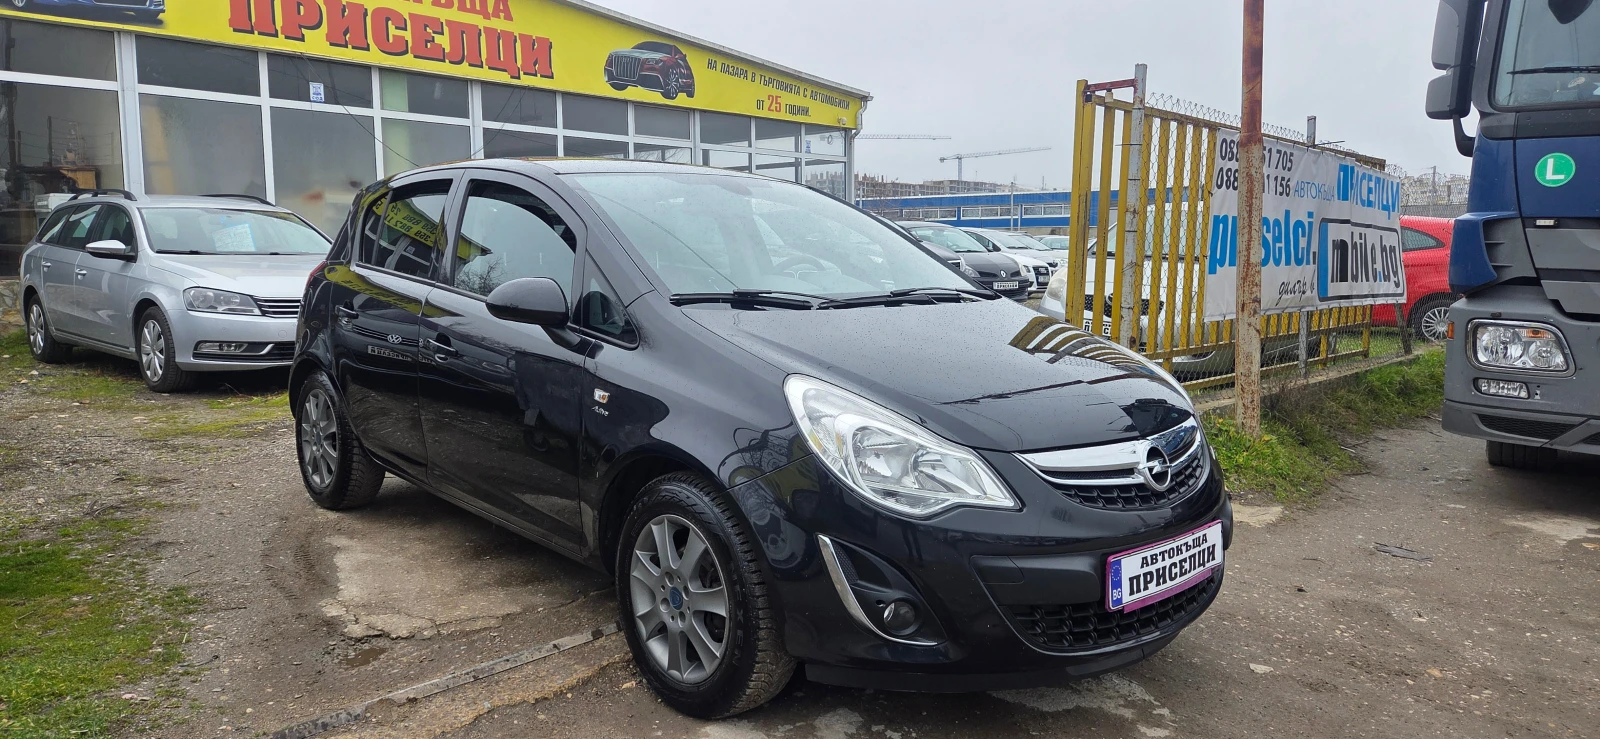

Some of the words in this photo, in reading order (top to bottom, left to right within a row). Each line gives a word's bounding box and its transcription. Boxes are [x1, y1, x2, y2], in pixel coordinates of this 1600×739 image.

[229, 0, 553, 79] ПРИСЕЛЦИ
[707, 58, 717, 71] НА
[720, 62, 748, 81] ПАЗАРА
[751, 73, 756, 83] В
[759, 74, 800, 96] ТЪРГОВИЯТА
[803, 87, 808, 98] С
[810, 88, 850, 110] АВТОМОБИЛИ
[756, 99, 765, 111] ОТ
[767, 94, 782, 113] 25
[785, 103, 811, 117] ГОДИНИ.
[1275, 149, 1294, 172] 705
[1546, 158, 1565, 181] L
[1273, 175, 1291, 197] 156
[1140, 533, 1208, 569] АВТОКЪЩА
[1128, 543, 1216, 597] ПРИСЕЛЦИ
[1112, 588, 1122, 601] BG
